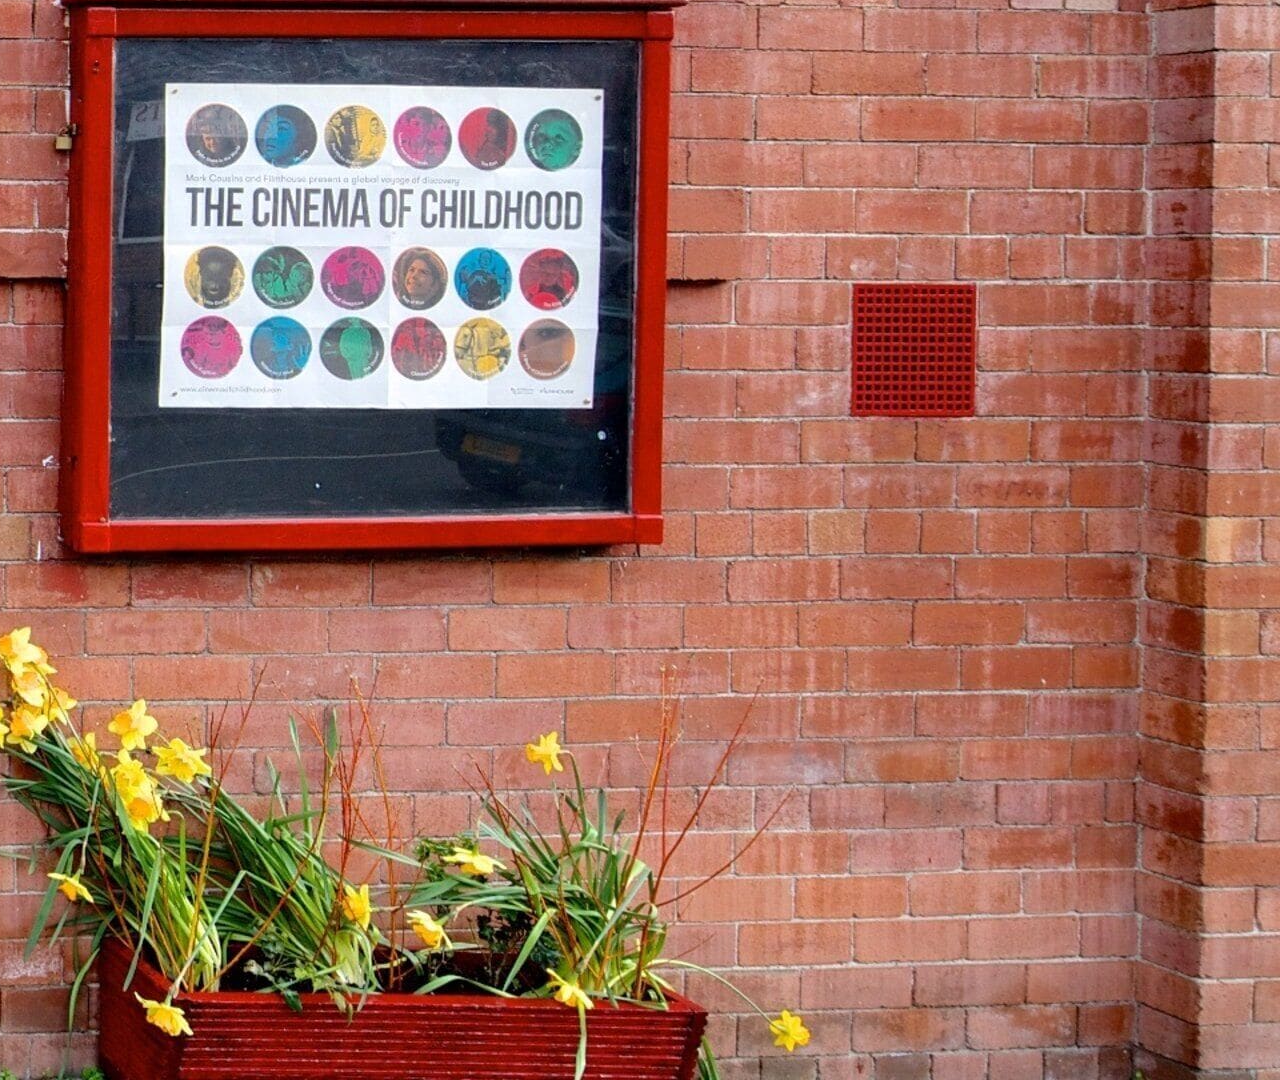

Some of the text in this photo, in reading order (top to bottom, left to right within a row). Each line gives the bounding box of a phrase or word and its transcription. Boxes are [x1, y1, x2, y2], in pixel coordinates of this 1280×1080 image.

[186, 174, 207, 183] Mark
[209, 174, 244, 184] Cousins
[244, 175, 262, 183] and
[263, 175, 307, 184] Filmhouse
[308, 176, 342, 186] present
[351, 175, 380, 186] global
[381, 177, 410, 187] voyage
[411, 175, 421, 184] of
[422, 176, 461, 187] discovery
[185, 187, 583, 231] THE CINEMA OF CHILDHOOD
